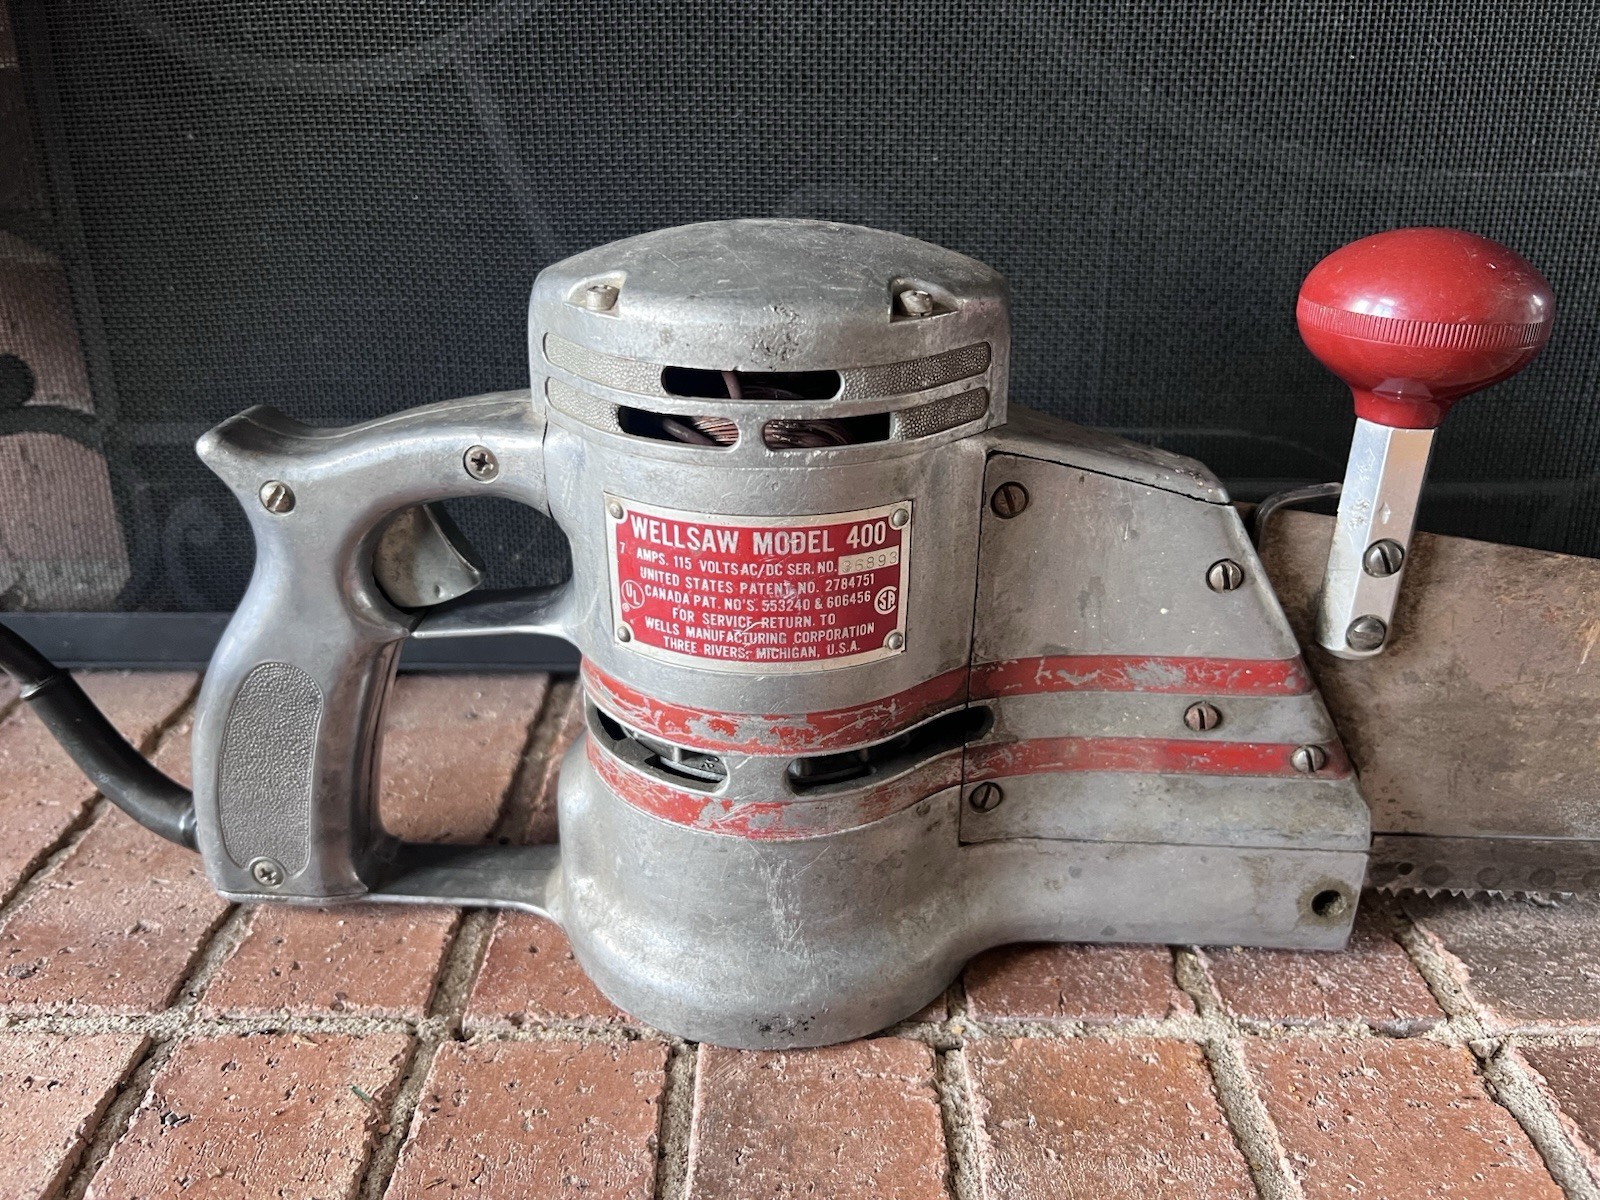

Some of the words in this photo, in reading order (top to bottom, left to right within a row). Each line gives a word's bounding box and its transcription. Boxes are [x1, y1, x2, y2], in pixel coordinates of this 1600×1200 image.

[630, 514, 739, 554] WELLSAW
[752, 530, 834, 556] MODEL
[846, 521, 886, 549] 400
[619, 541, 625, 554] 7
[636, 547, 668, 567] AMPS.
[673, 555, 692, 570] 115
[699, 560, 738, 575] VOLTS
[740, 563, 783, 578] AC/DC
[787, 562, 814, 576] SER.
[817, 560, 838, 574] NO.
[640, 567, 679, 587] UNITED
[685, 576, 733, 594] STATES
[740, 582, 790, 596] PATENT
[797, 581, 819, 594] NO.
[825, 573, 874, 592] 2784751
[644, 584, 690, 605] CANADA
[693, 595, 721, 610] PAT.
[724, 599, 759, 612] NO'S.
[762, 600, 811, 612] 553240
[814, 598, 823, 610] &
[826, 590, 871, 609] 606456
[644, 615, 680, 636] WELLS
[686, 626, 787, 645] MANUFACTURING
[793, 622, 875, 643] CORPORATION
[672, 607, 695, 623] FOR
[702, 613, 753, 629] SERVICE
[820, 613, 836, 626] TO
[663, 635, 697, 654] THREE
[826, 640, 861, 656] U.S.A.
